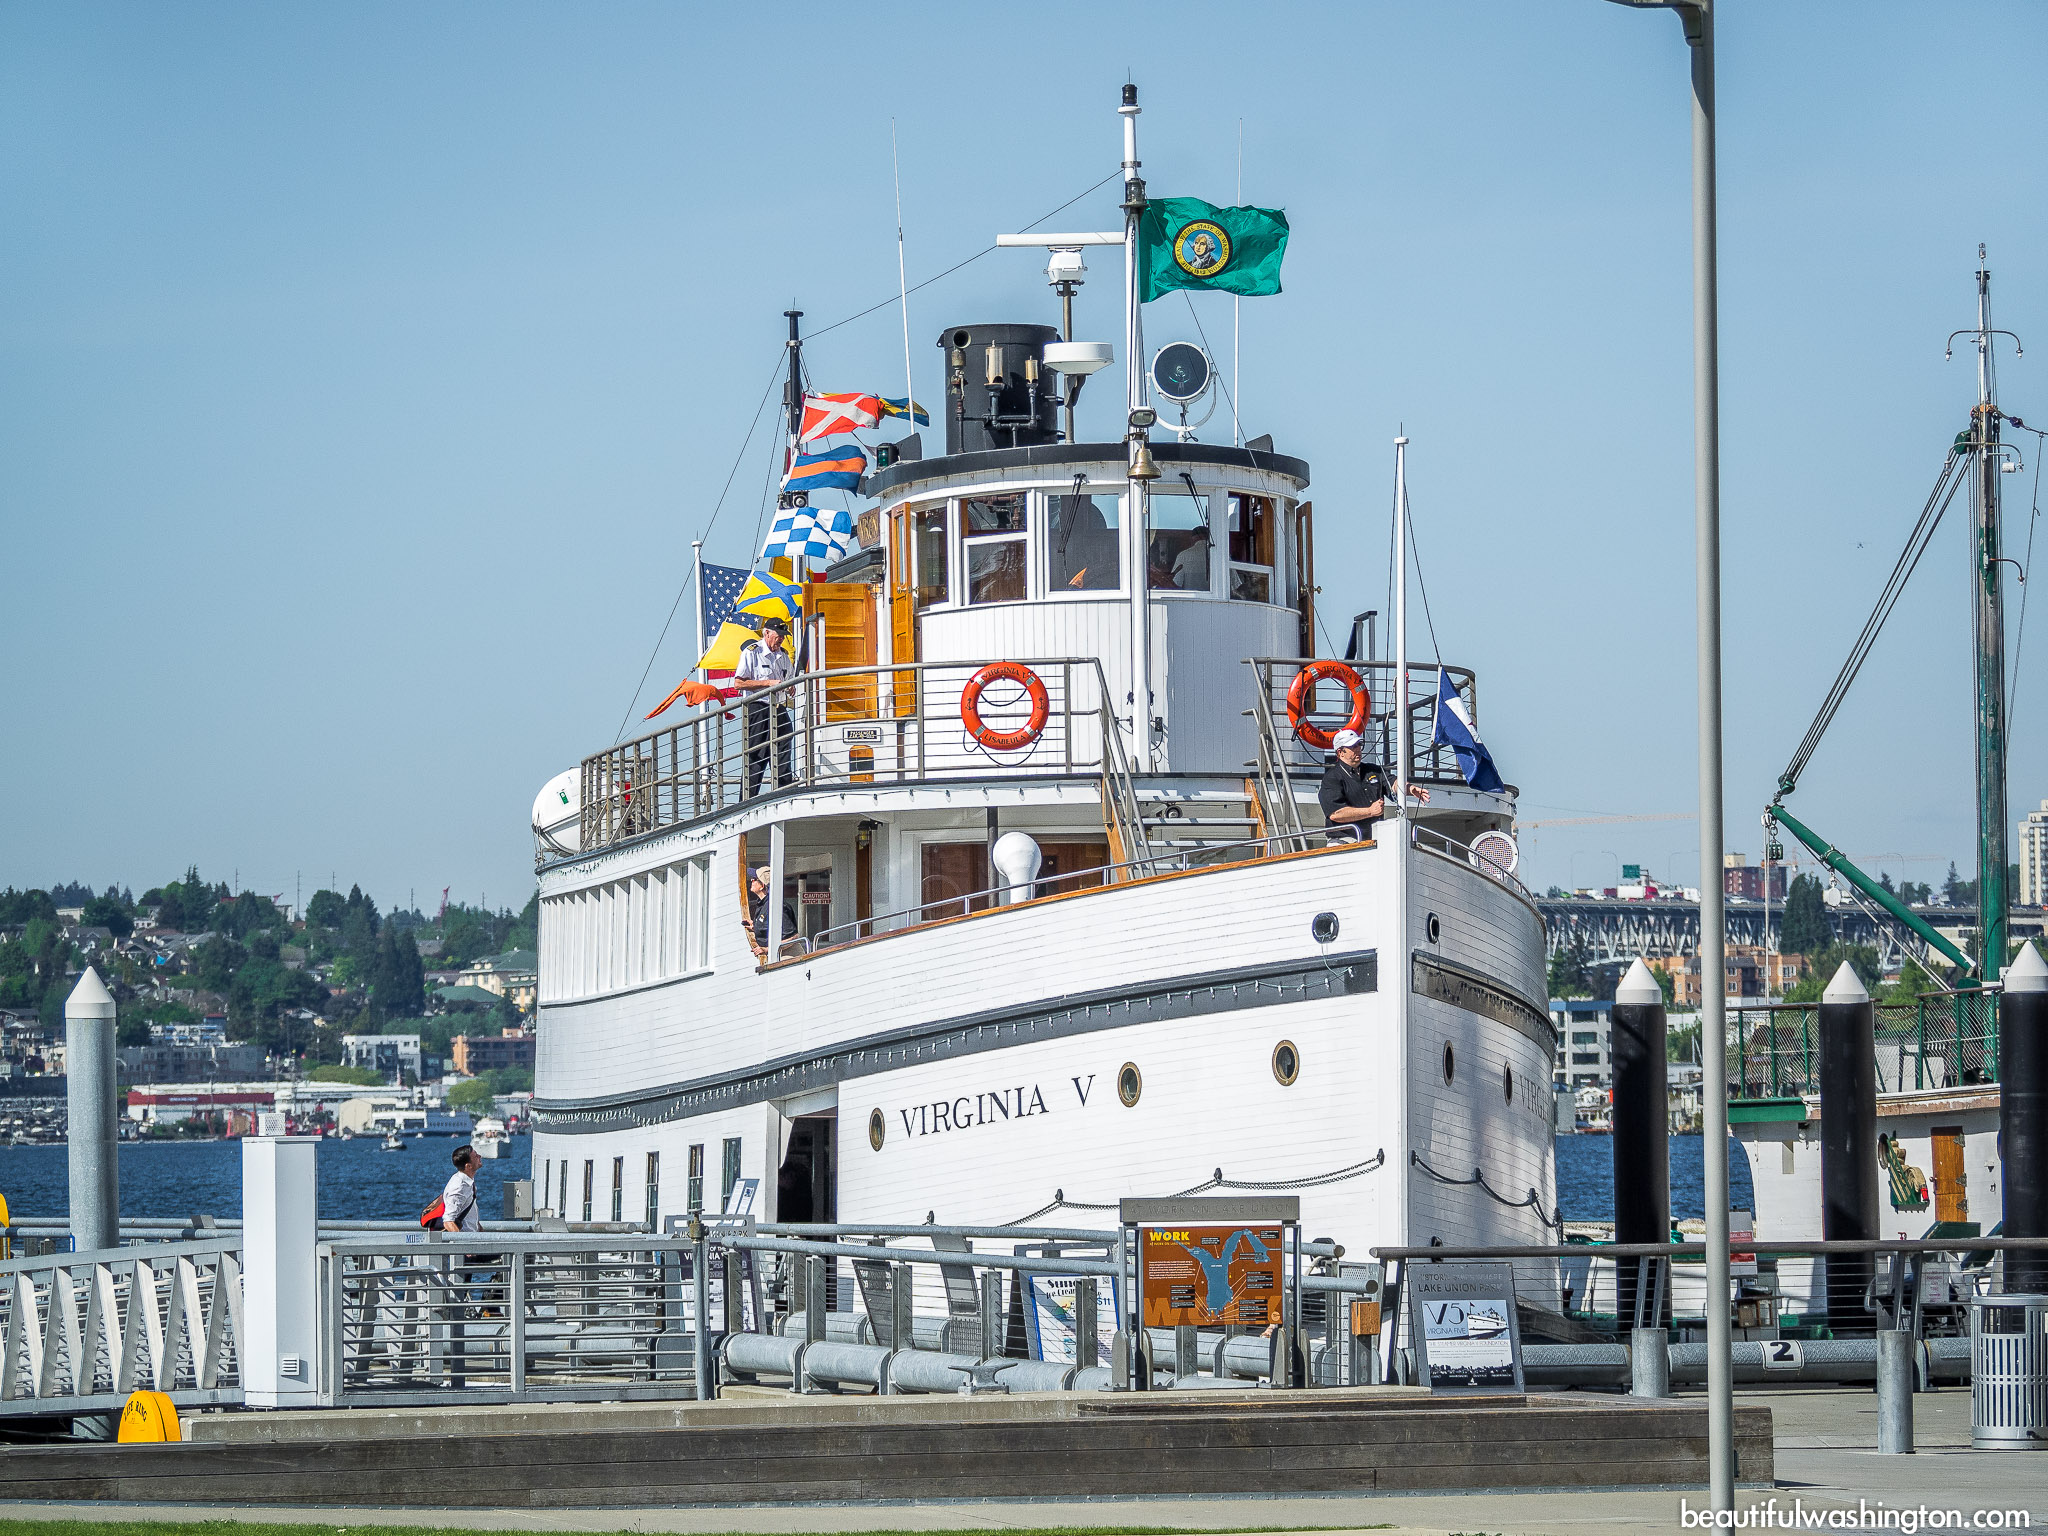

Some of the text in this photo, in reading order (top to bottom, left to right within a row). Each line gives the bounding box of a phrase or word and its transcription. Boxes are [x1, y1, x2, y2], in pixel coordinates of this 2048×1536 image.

[981, 666, 1019, 679] VIRGINIA
[900, 1074, 1096, 1138] VIRGINIA V
[1149, 1205, 1185, 1214] WORK
[1192, 1205, 1209, 1214] ON
[1216, 1204, 1244, 1214] LAKE
[1149, 1232, 1190, 1241] WORK
[1418, 1284, 1503, 1292] LAKE UNION PARK
[1424, 1303, 1464, 1324] V5
[1770, 1342, 1794, 1361] 2
[136, 1400, 148, 1422] RING
